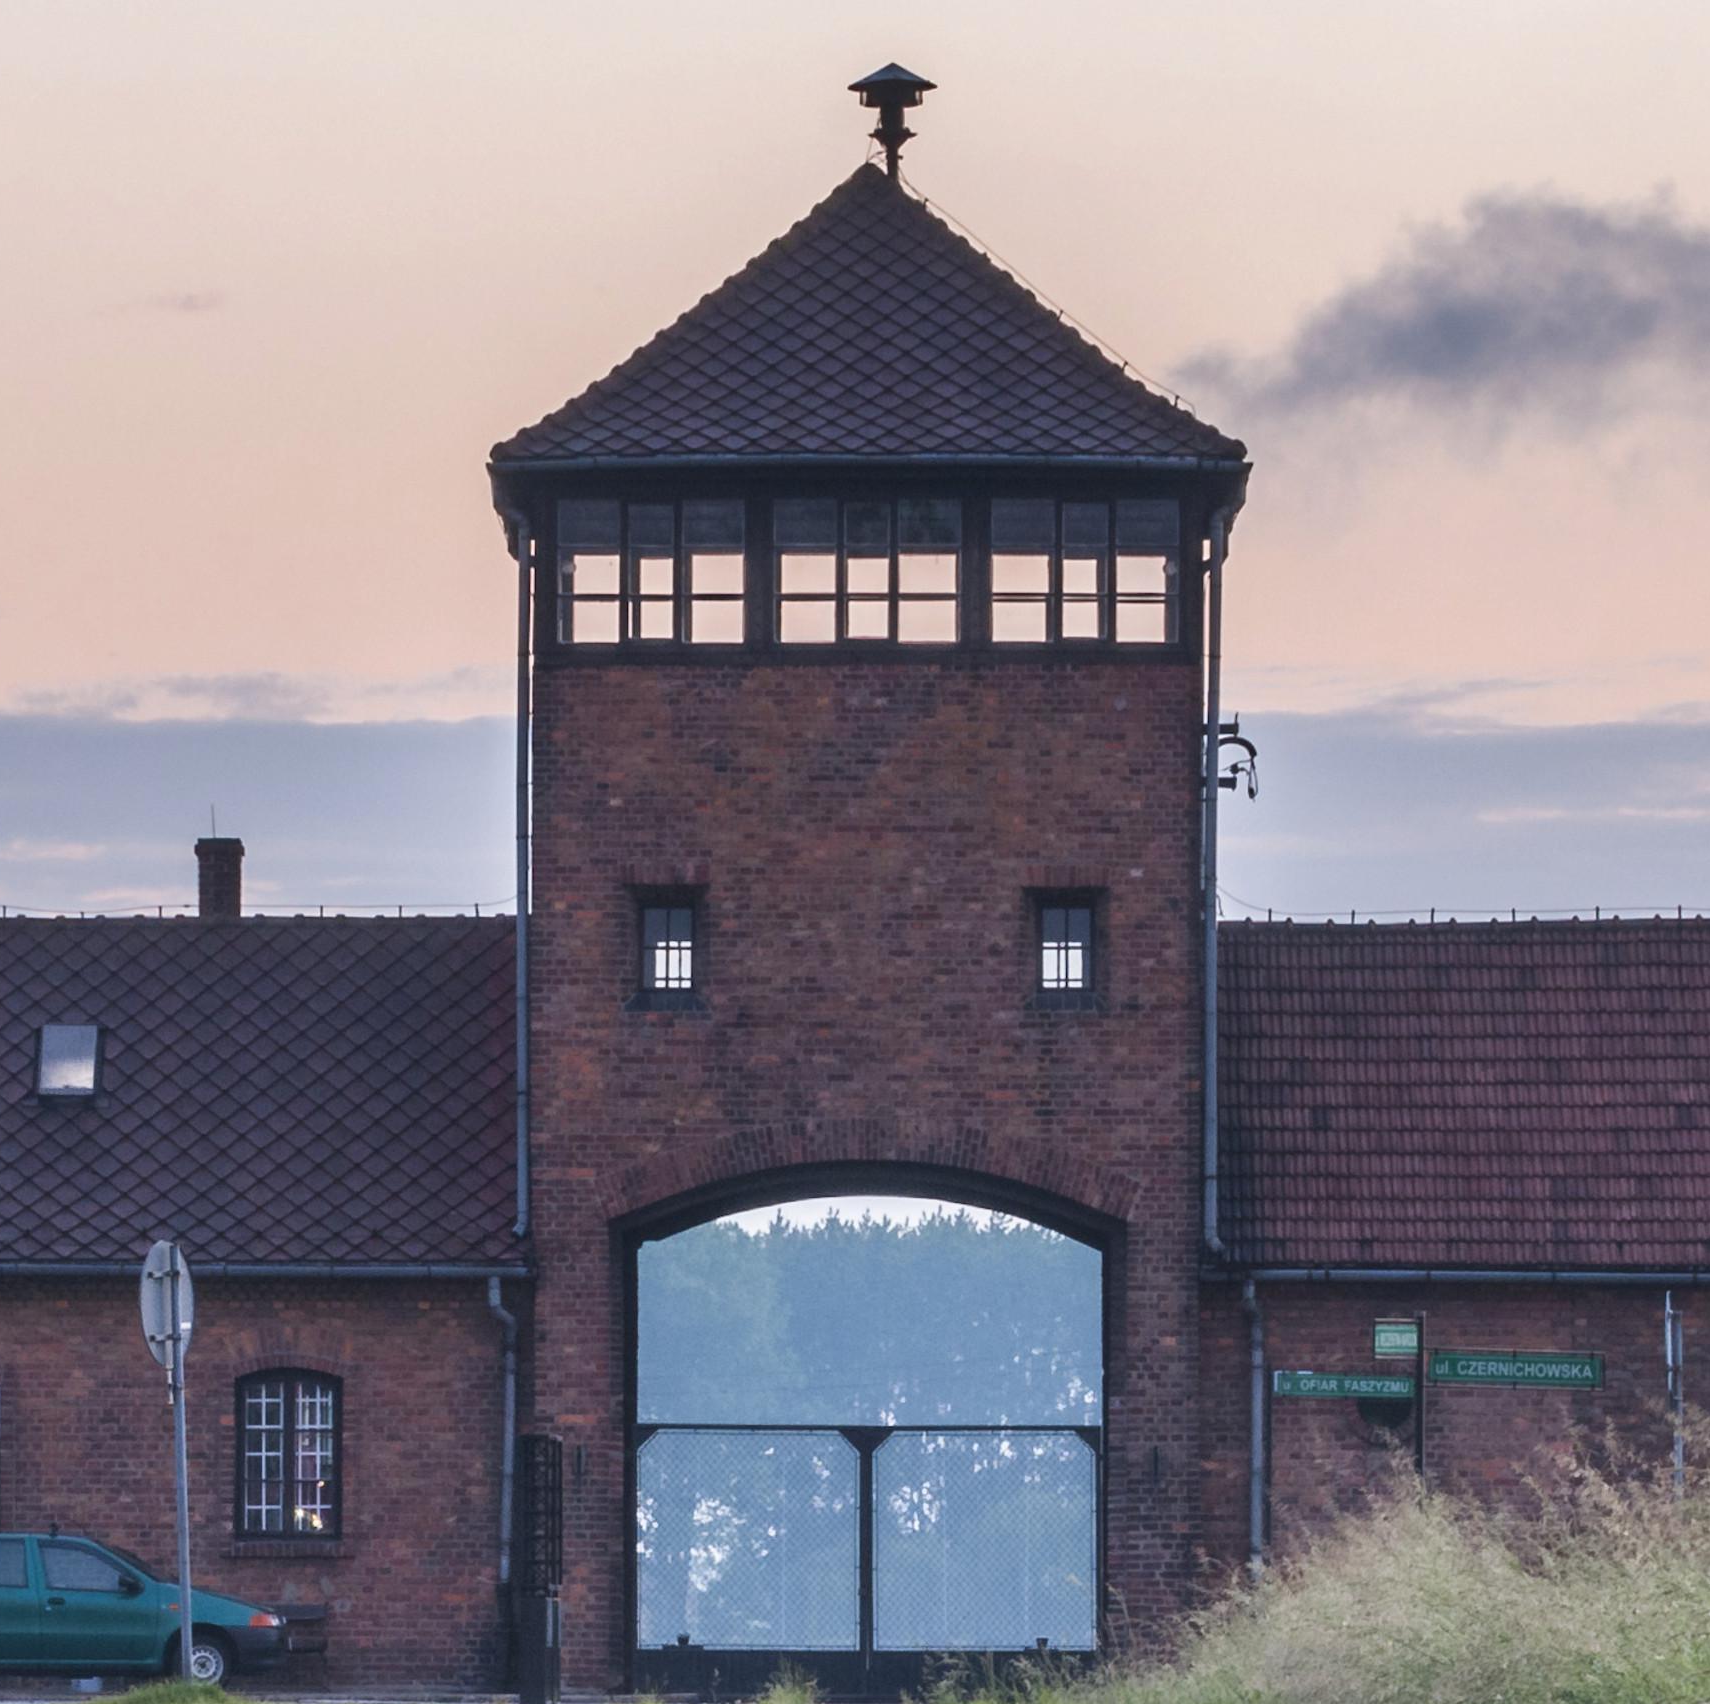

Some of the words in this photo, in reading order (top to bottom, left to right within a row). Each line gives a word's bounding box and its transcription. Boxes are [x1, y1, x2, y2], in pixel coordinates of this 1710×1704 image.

[1457, 1361, 1593, 1379] CZERNICHOWSKA
[1299, 1379, 1338, 1392] OFIAR
[1344, 1380, 1410, 1393] FASZYZMU
